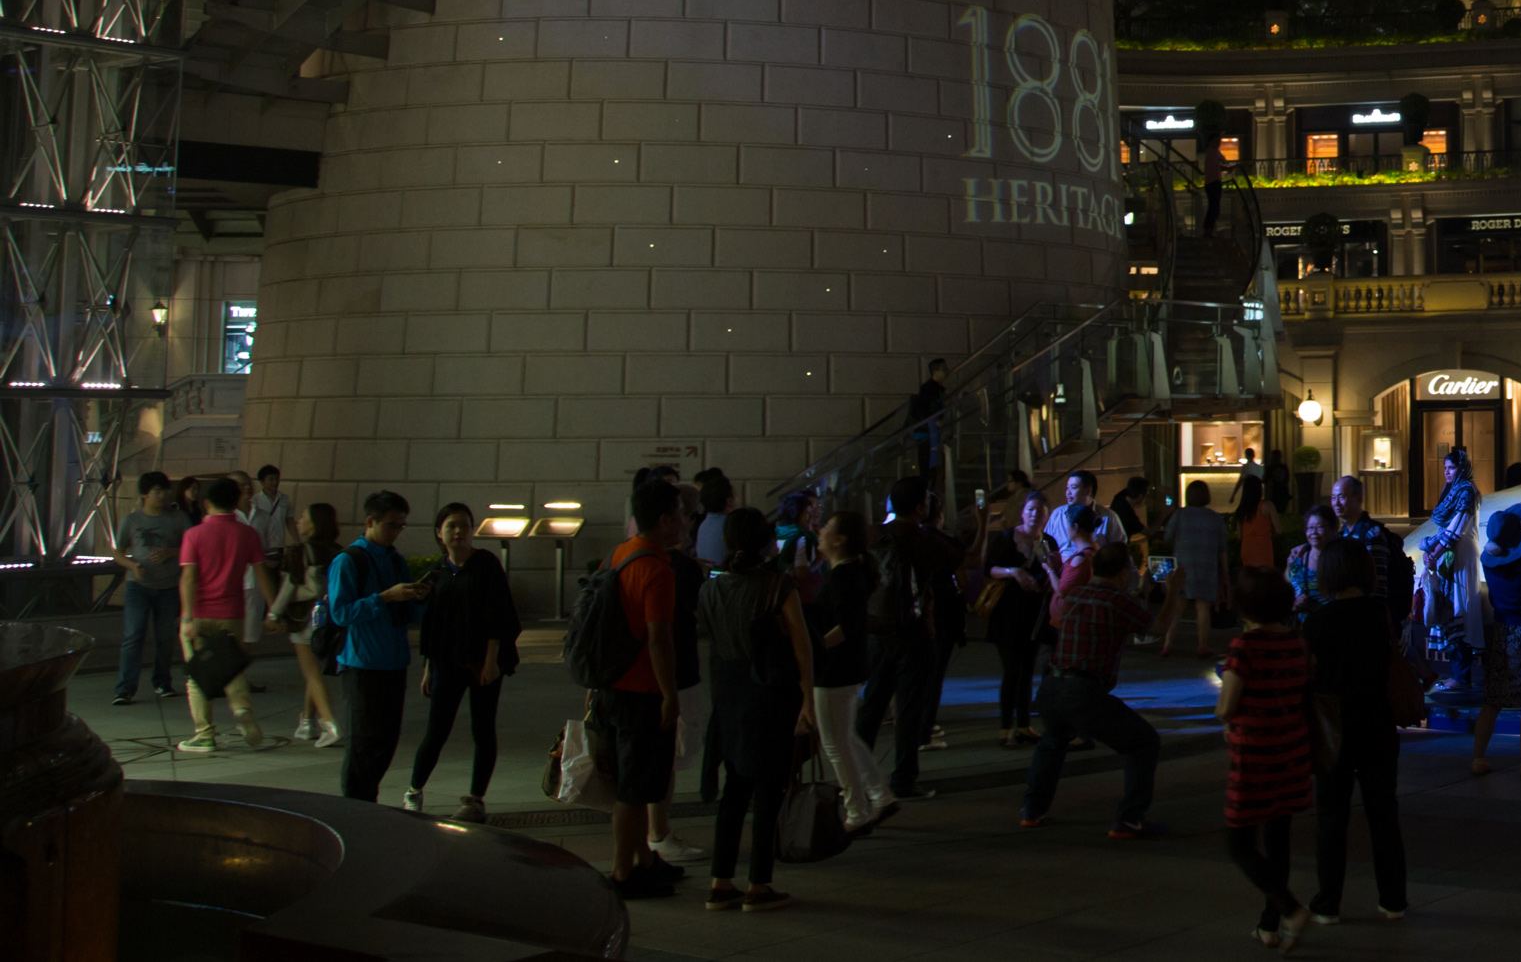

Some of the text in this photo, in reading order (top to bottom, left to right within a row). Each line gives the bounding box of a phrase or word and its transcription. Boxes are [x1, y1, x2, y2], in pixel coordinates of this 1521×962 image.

[957, 5, 1119, 182] 1881
[1471, 220, 1512, 231] ROGER
[1428, 374, 1499, 395] Cartier
